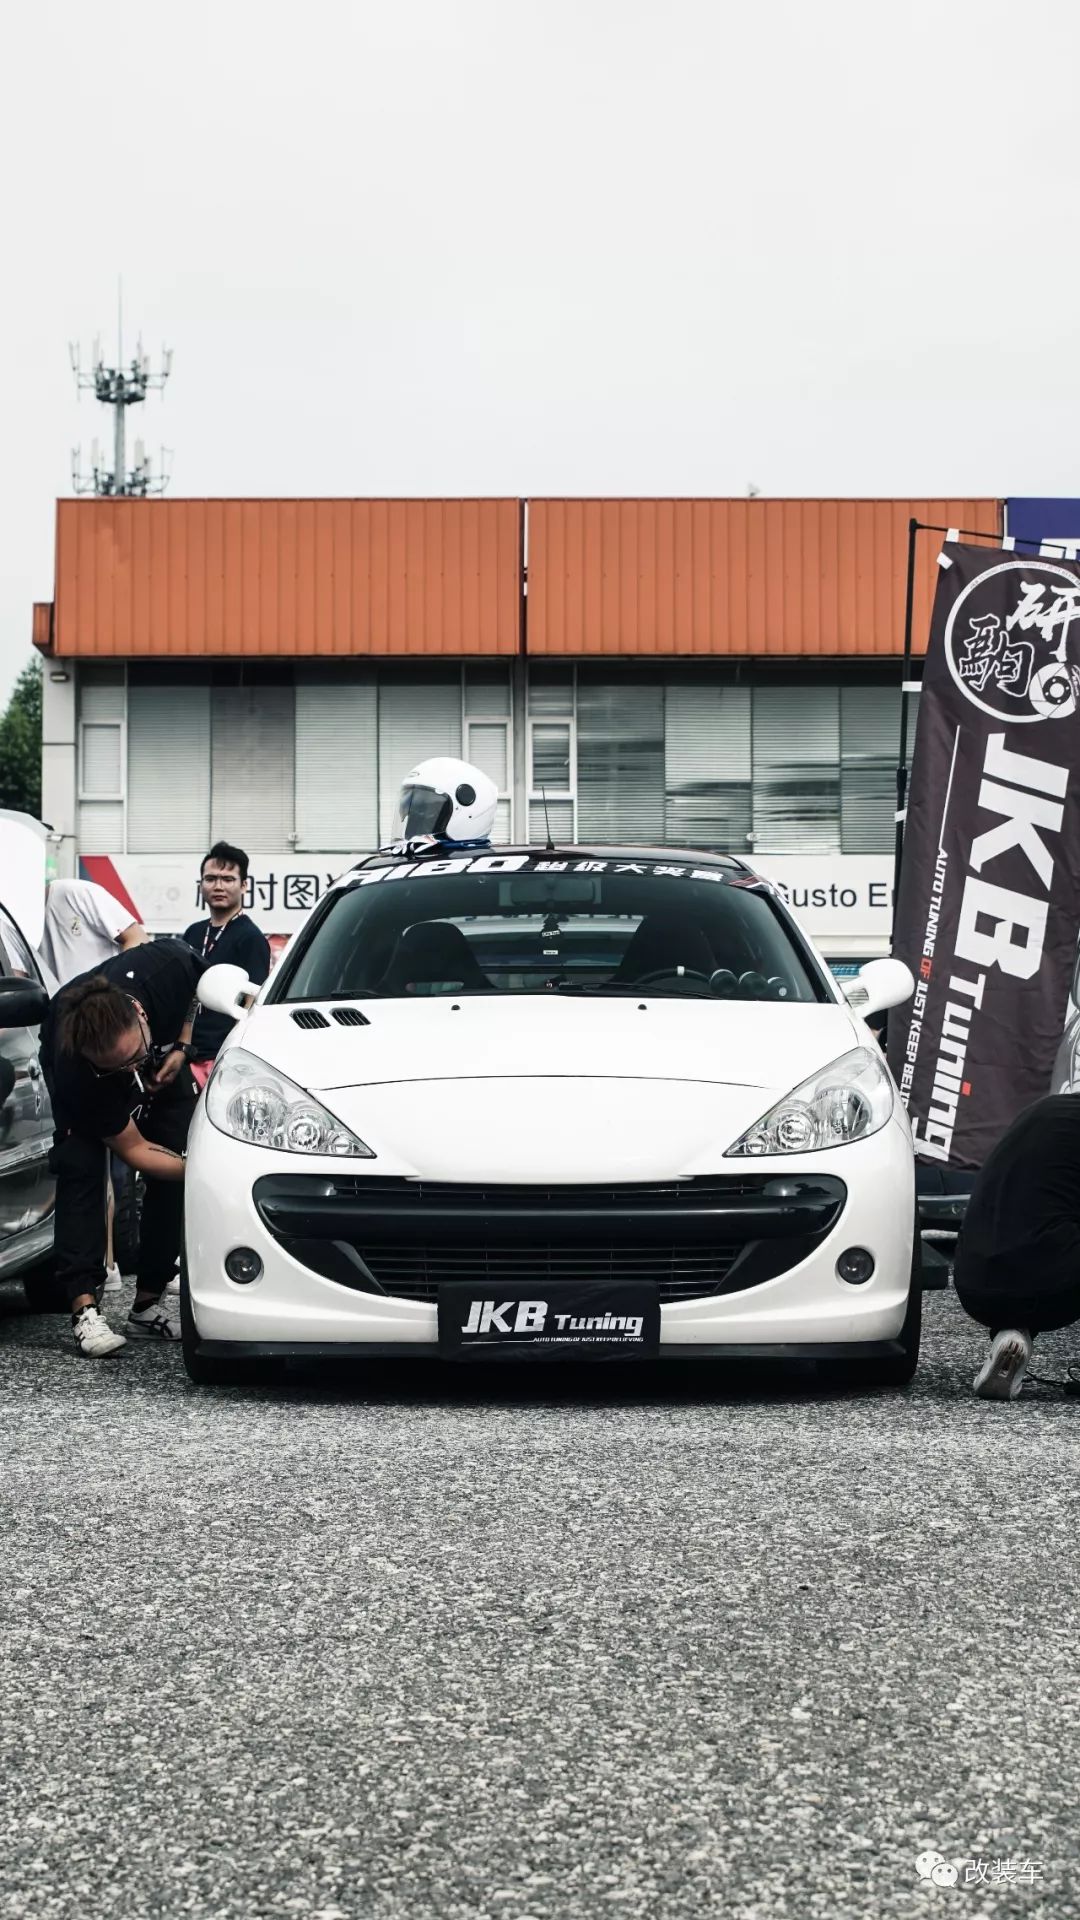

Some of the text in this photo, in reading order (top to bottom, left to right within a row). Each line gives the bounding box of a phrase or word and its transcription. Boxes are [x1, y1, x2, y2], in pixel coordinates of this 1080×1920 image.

[932, 847, 949, 893] AUTO
[868, 882, 894, 907] E
[922, 895, 942, 957] TUNING
[911, 732, 1070, 1162] JKB Tuning
[919, 957, 933, 979] OF
[912, 980, 929, 1019] JUST
[906, 1019, 923, 1063] KEEP
[461, 1301, 644, 1337] JKB Tuning
